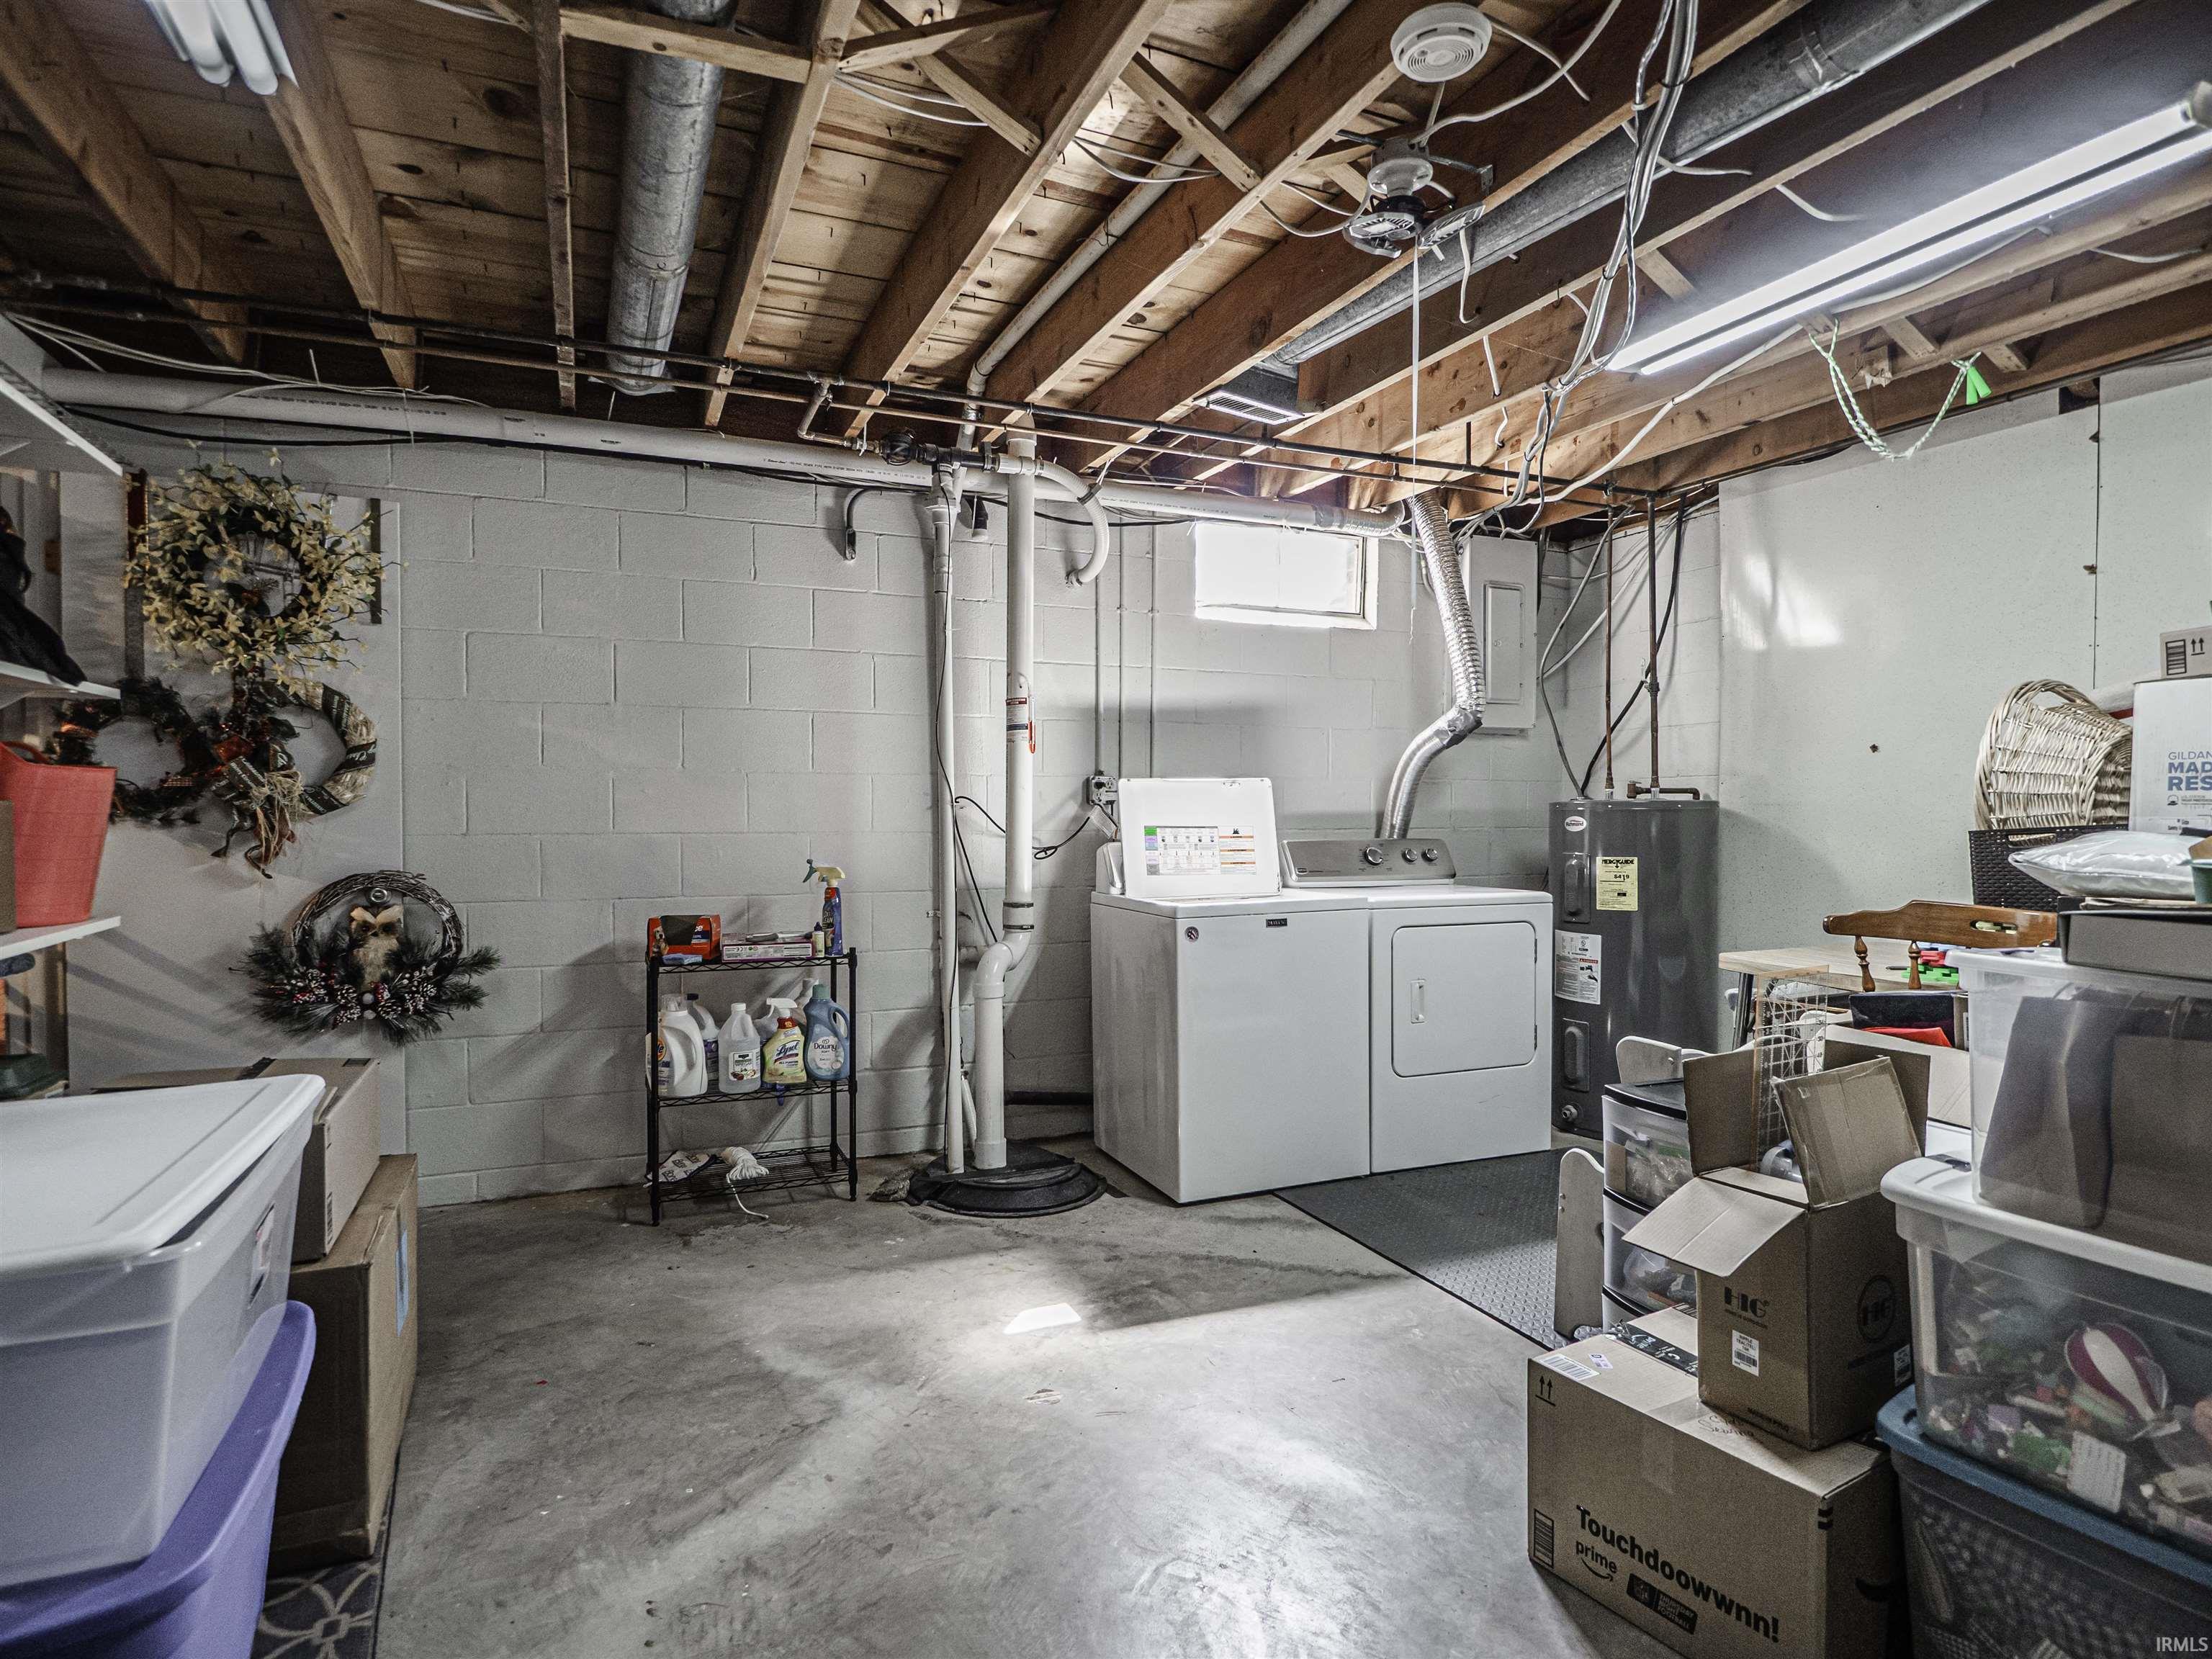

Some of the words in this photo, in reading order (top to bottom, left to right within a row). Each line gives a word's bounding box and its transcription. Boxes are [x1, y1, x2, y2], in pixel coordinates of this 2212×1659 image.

[2167, 750, 2212, 760] GILDAN
[2167, 761, 2212, 774] MAD
[2167, 775, 2212, 791] RES
[776, 1041, 800, 1056] Lysol
[814, 1042, 837, 1052] Downy
[1575, 1541, 1618, 1574] prime
[1576, 1504, 1779, 1643] Touchdoowwnn!
